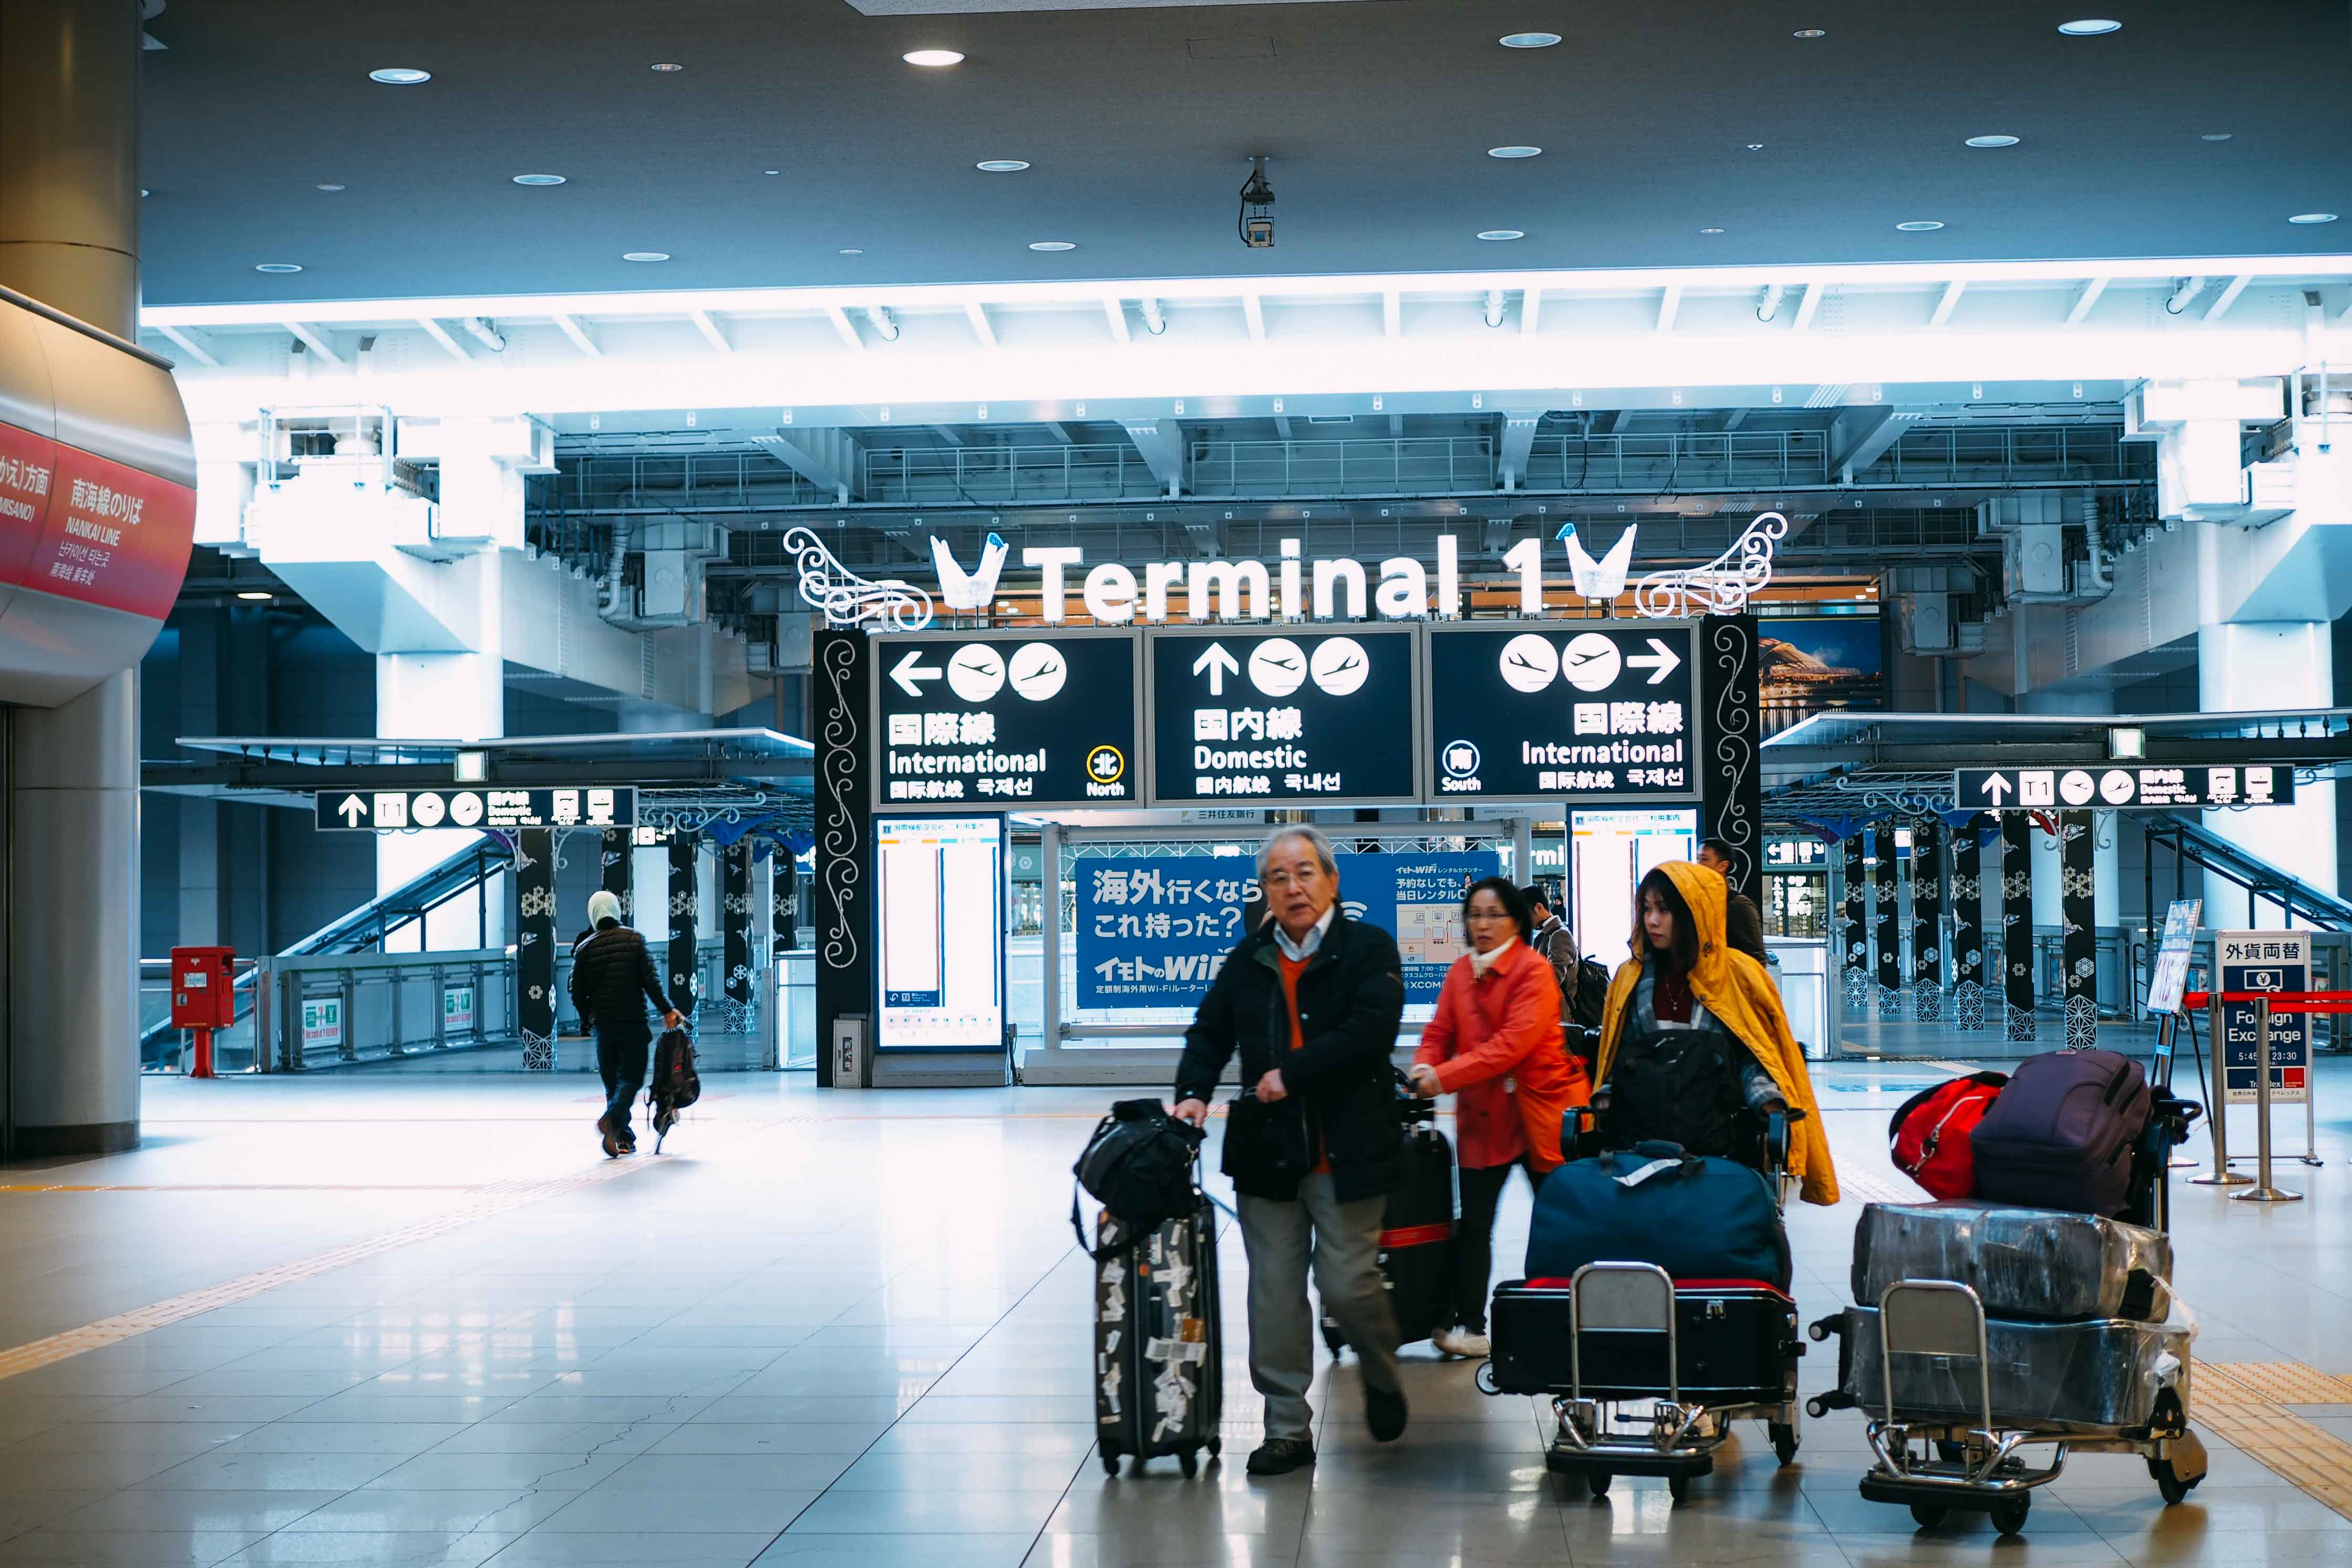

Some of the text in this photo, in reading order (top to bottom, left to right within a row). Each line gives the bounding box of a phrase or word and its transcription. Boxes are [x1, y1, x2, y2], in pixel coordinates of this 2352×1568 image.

[71, 478, 143, 525] 南海線のりば
[65, 517, 121, 546] NANKAI LINE
[1023, 534, 1543, 623] Terminal 1
[888, 712, 996, 747] 国際線
[1194, 707, 1303, 741] 国内線
[1574, 701, 1684, 736] 国際線
[889, 748, 1046, 775] International
[1092, 752, 1118, 776] 北
[1194, 744, 1307, 770] Domestic
[1522, 740, 1683, 765] International
[1086, 782, 1125, 797] North
[1441, 776, 1481, 791] South
[2140, 783, 2186, 795] Domestic
[1198, 809, 1255, 819] 三井住友銀行
[1498, 844, 1564, 866] Tmi
[1092, 869, 1262, 905] 海外行くなら
[1396, 878, 1462, 889] 予約なしでも、
[1095, 906, 1241, 938] これ持った?
[2226, 942, 2300, 960] 外貨両替
[2236, 1010, 2293, 1026] Foign
[2228, 1028, 2301, 1044] Excange
[2272, 1051, 2297, 1060] 23:30
